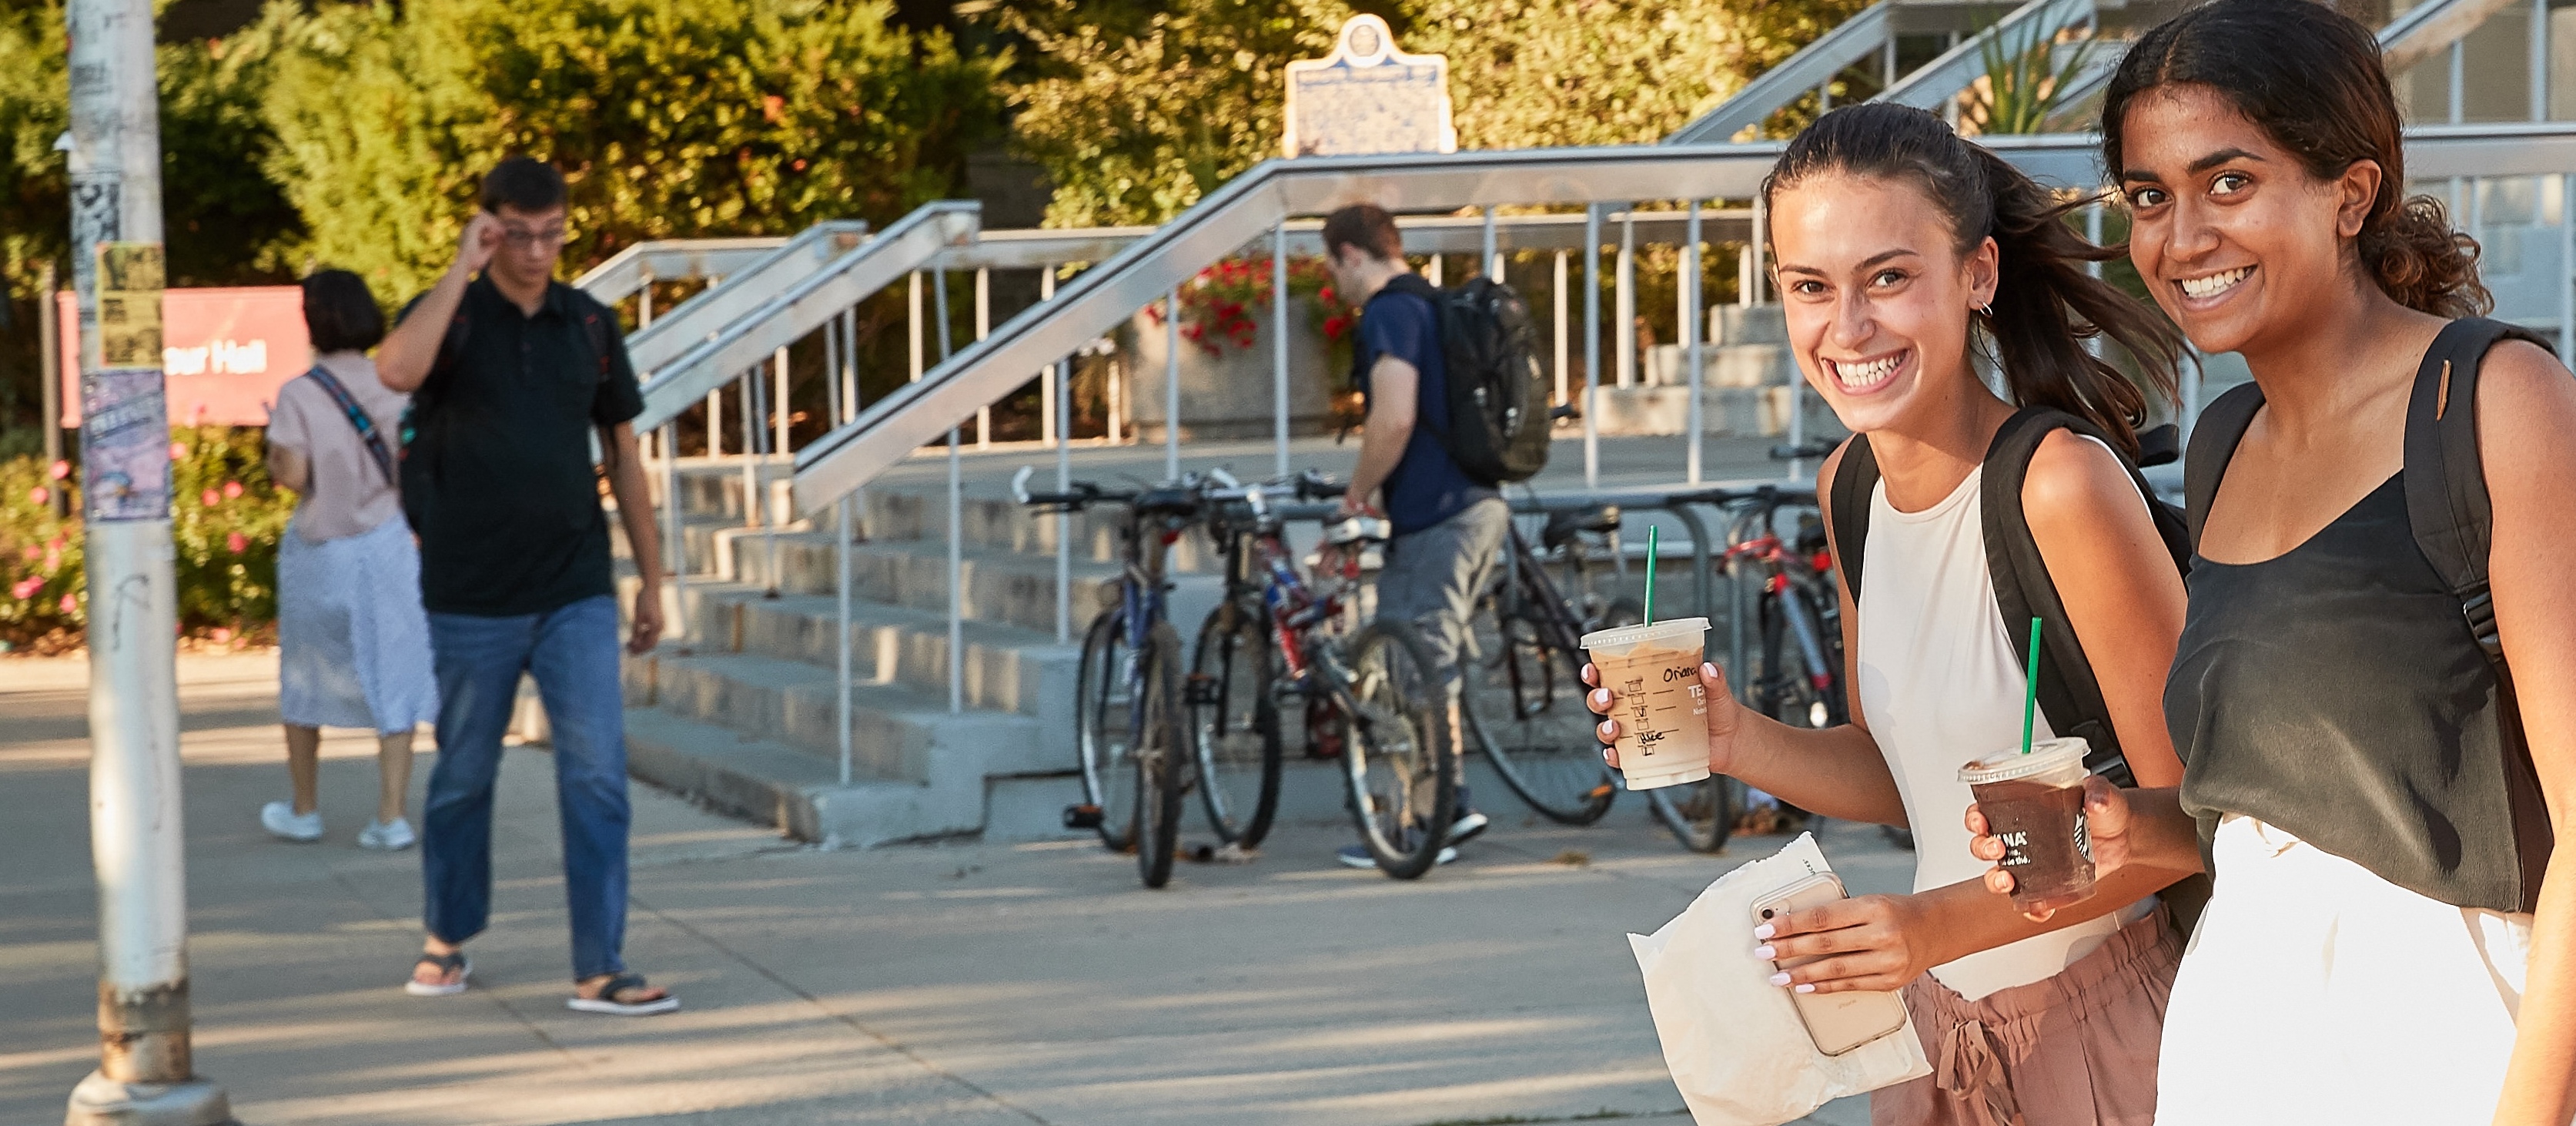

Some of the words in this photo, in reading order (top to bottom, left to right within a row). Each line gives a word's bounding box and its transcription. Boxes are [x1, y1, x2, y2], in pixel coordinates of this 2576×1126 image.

[162, 347, 209, 376] our
[211, 338, 267, 375] Hall
[1992, 831, 2028, 847] NA
